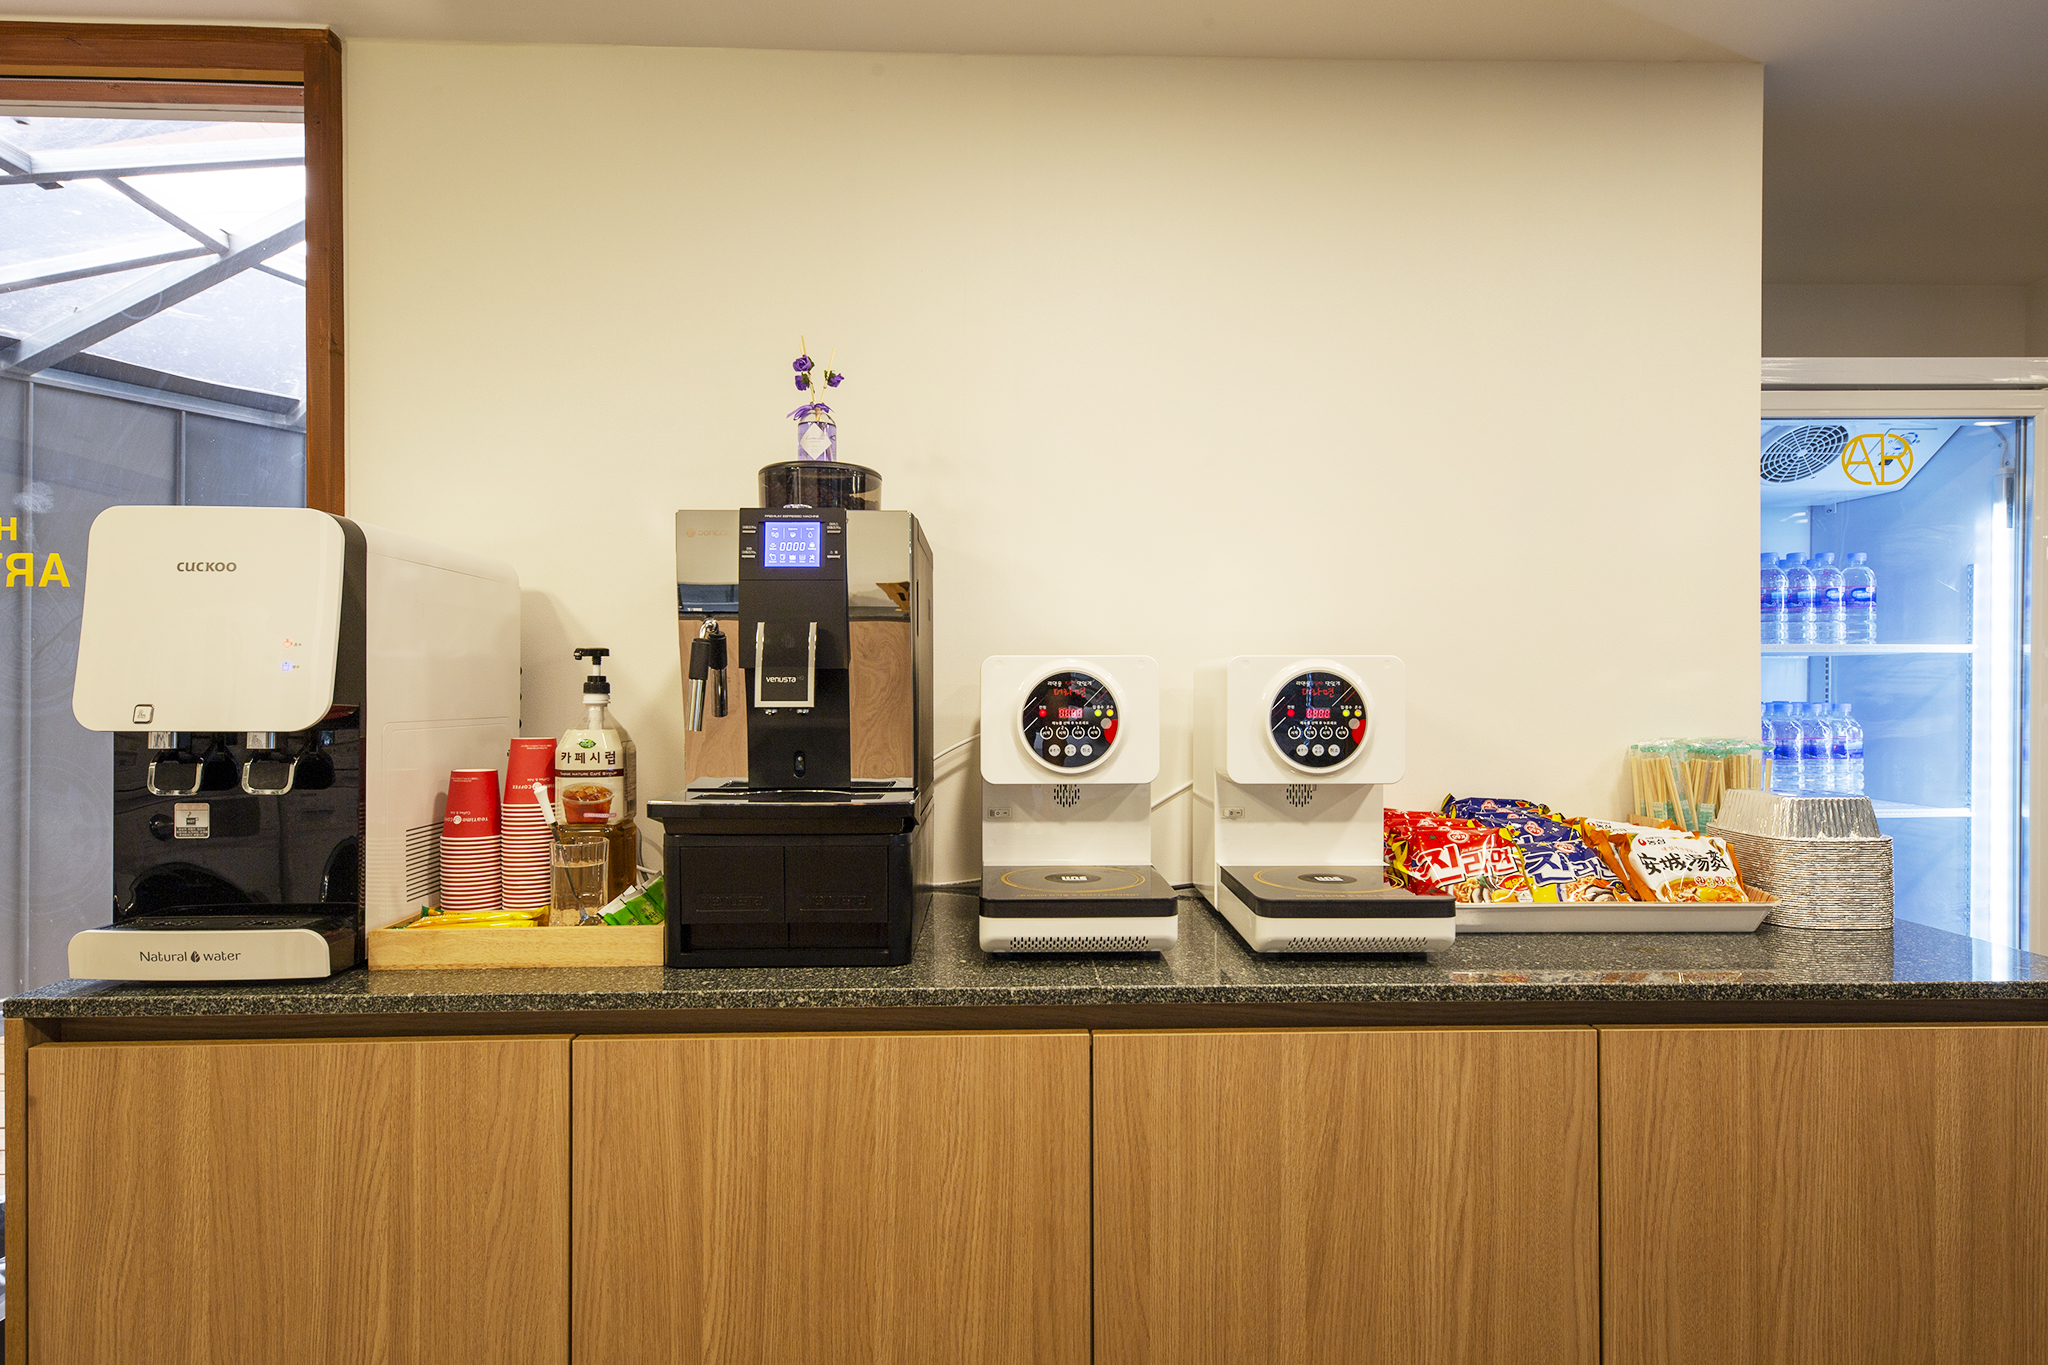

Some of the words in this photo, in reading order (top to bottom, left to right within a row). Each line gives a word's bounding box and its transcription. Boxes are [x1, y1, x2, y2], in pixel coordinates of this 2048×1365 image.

[780, 542, 806, 551] 0000
[140, 951, 187, 962] Natural
[203, 951, 241, 961] water
